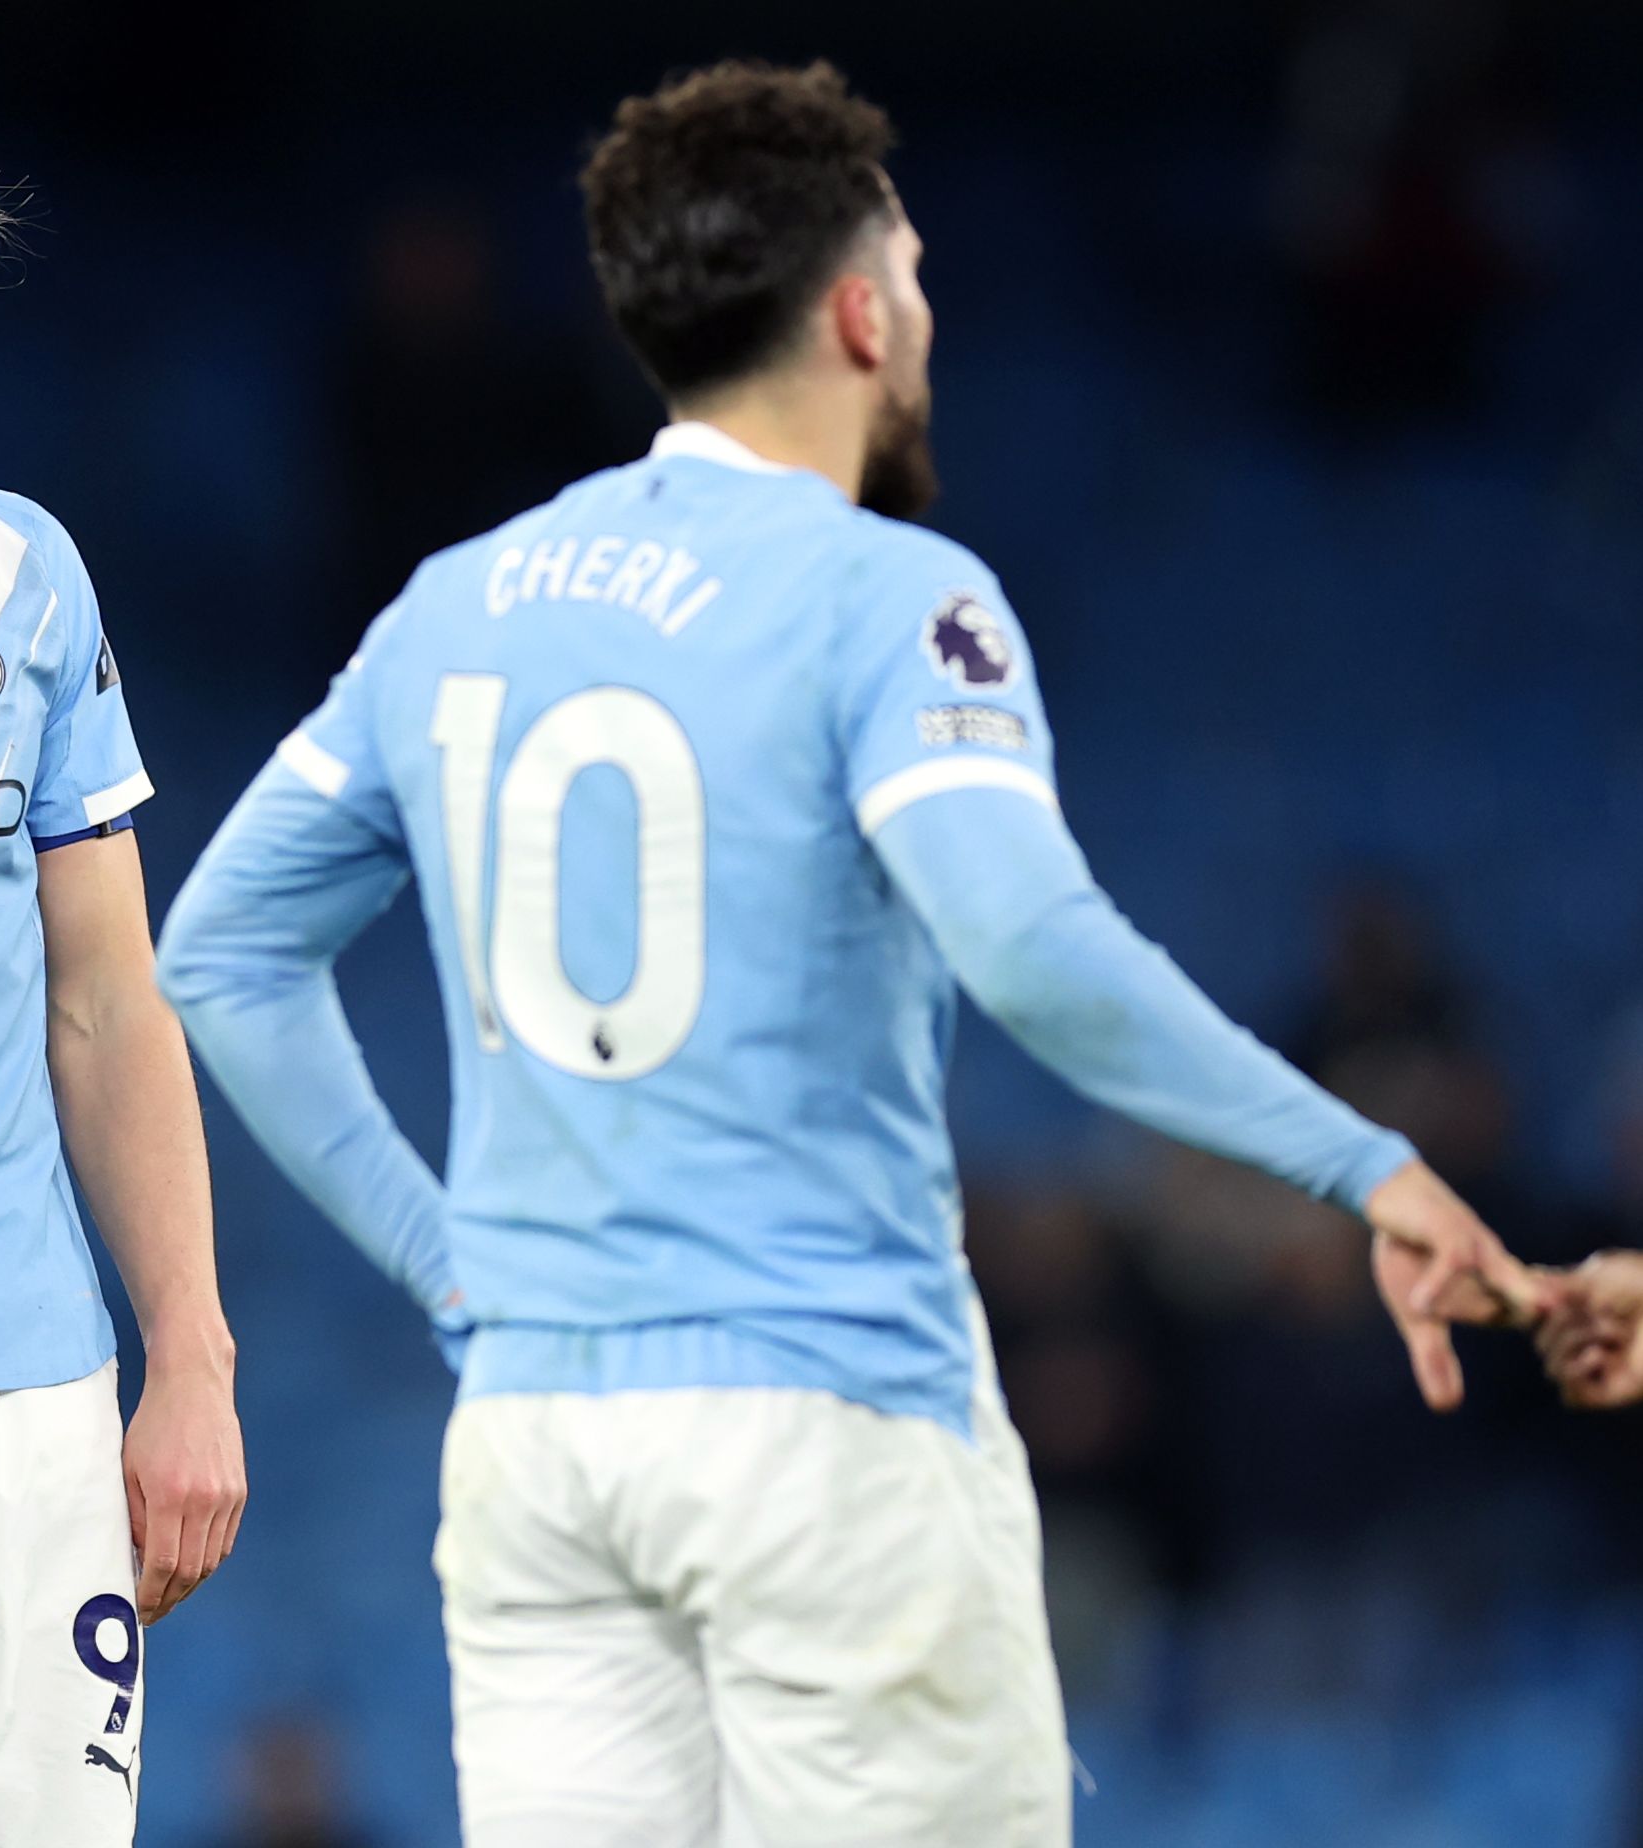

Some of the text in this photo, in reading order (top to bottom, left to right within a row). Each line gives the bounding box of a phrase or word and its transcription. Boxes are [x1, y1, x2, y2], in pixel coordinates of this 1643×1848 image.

[486, 536, 721, 636] CHERKI
[429, 673, 705, 1079] 10
[72, 1593, 139, 1734] 9
